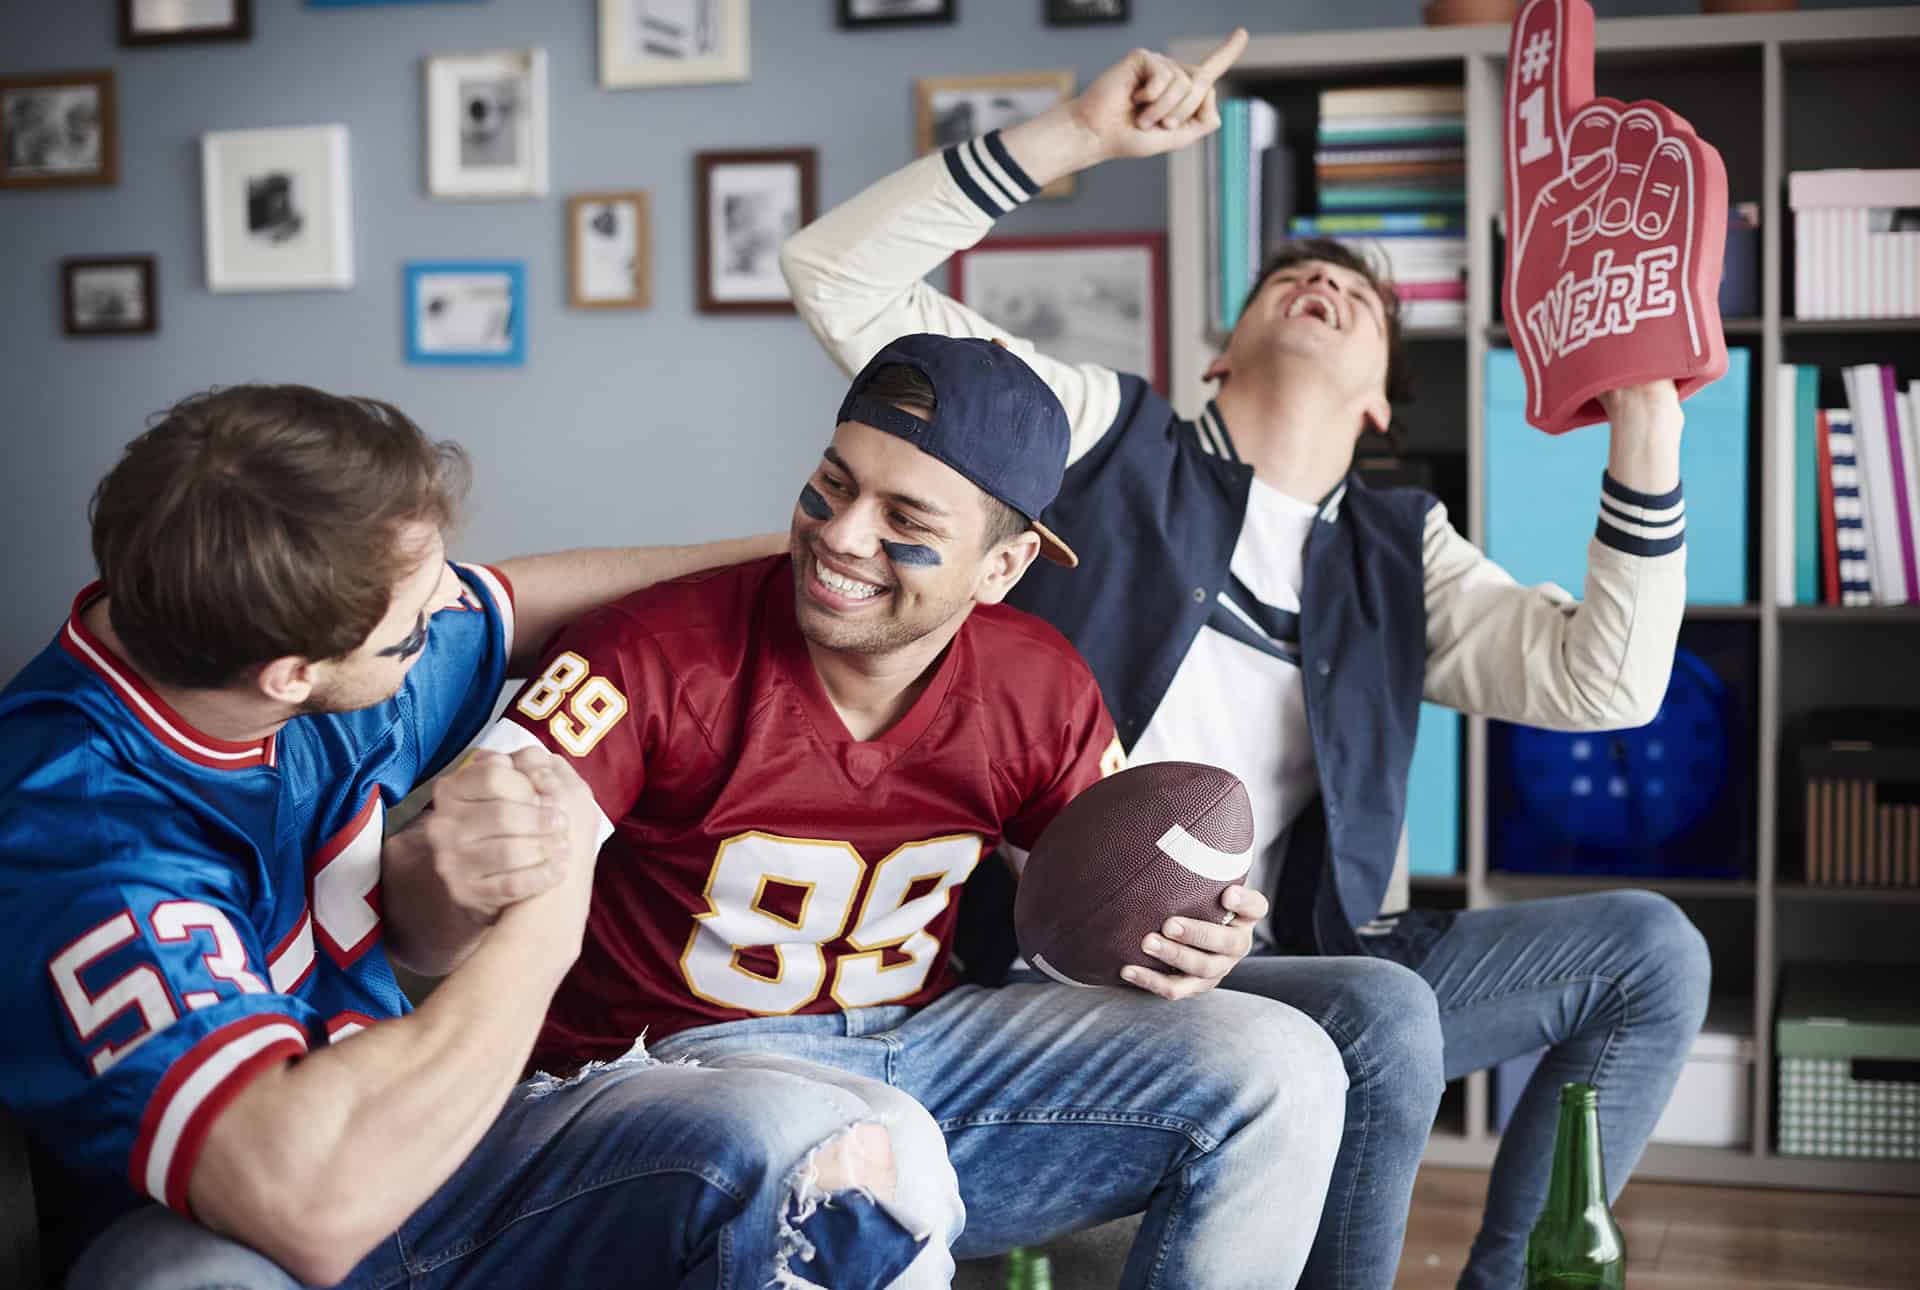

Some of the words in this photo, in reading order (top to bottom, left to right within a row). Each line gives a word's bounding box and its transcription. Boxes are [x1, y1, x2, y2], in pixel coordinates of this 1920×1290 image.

[516, 650, 628, 757] 89
[48, 899, 268, 1077] 53
[680, 831, 984, 1017] 89
